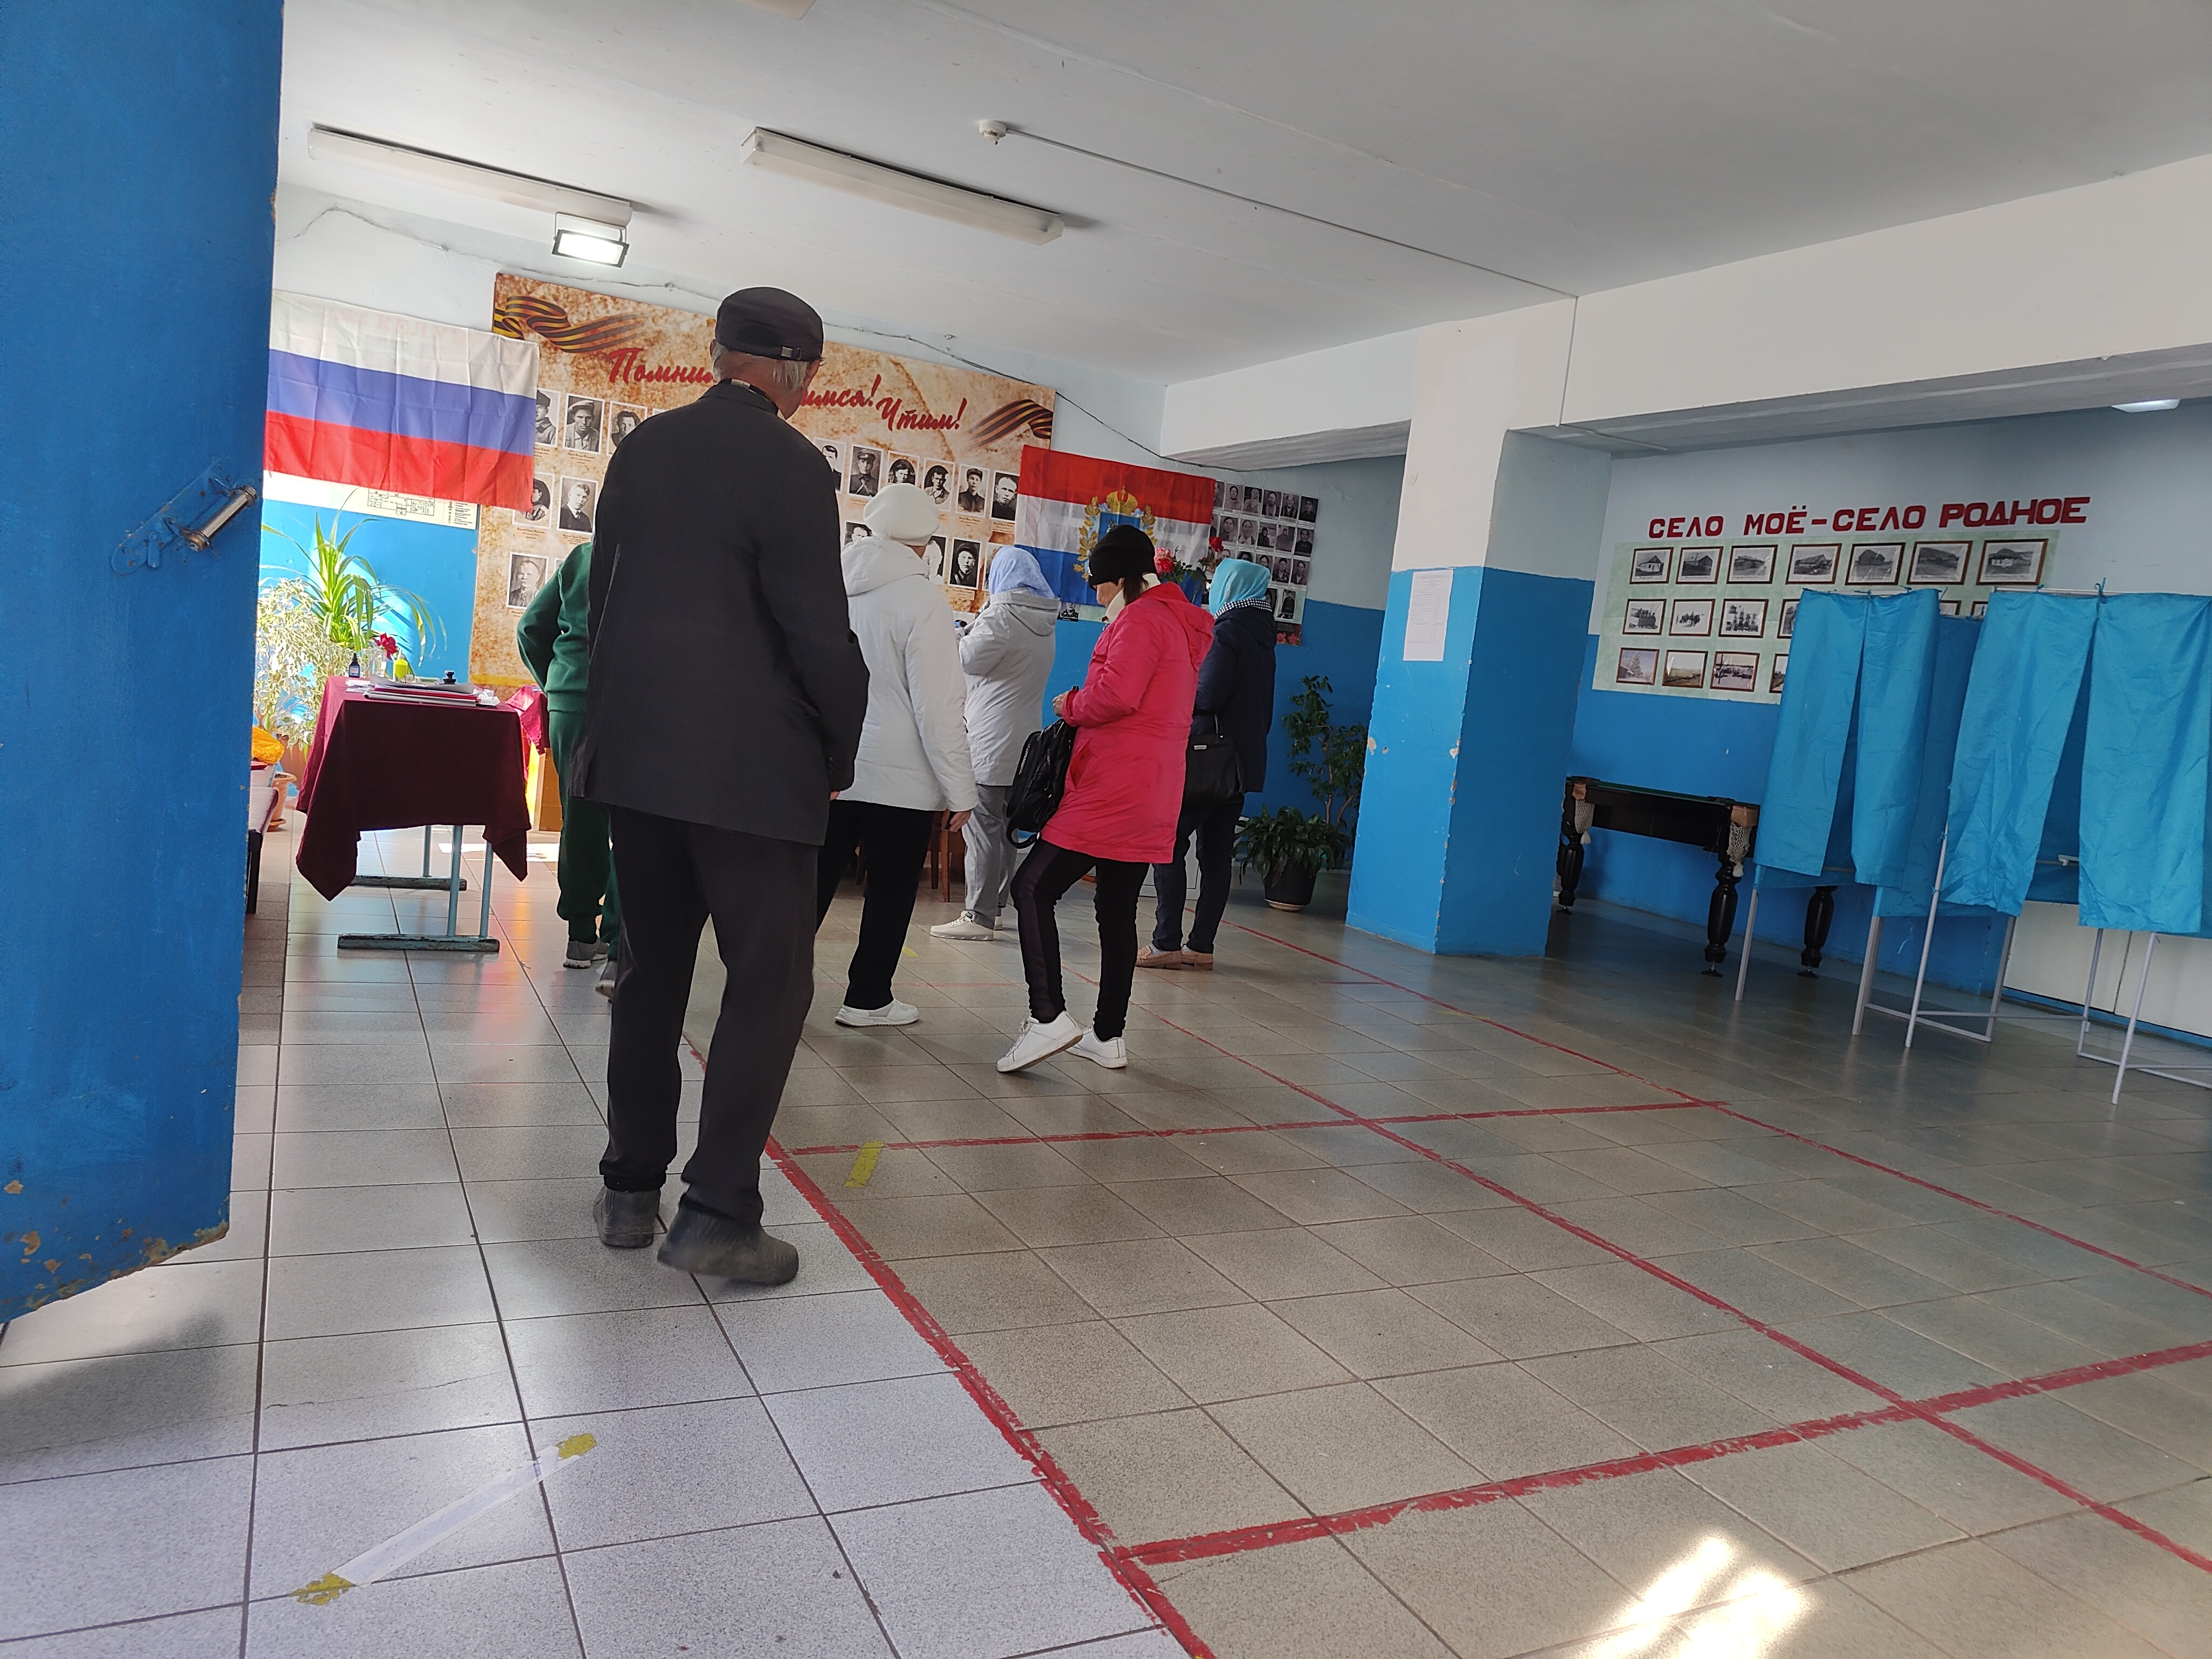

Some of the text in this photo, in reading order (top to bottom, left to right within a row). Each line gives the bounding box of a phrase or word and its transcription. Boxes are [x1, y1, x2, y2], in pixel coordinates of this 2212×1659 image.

[609, 347, 717, 385] Помни
[875, 397, 967, 431] Чтим!
[1649, 516, 1724, 538] СЕЛО
[1939, 496, 2091, 528] РОДНОЕ
